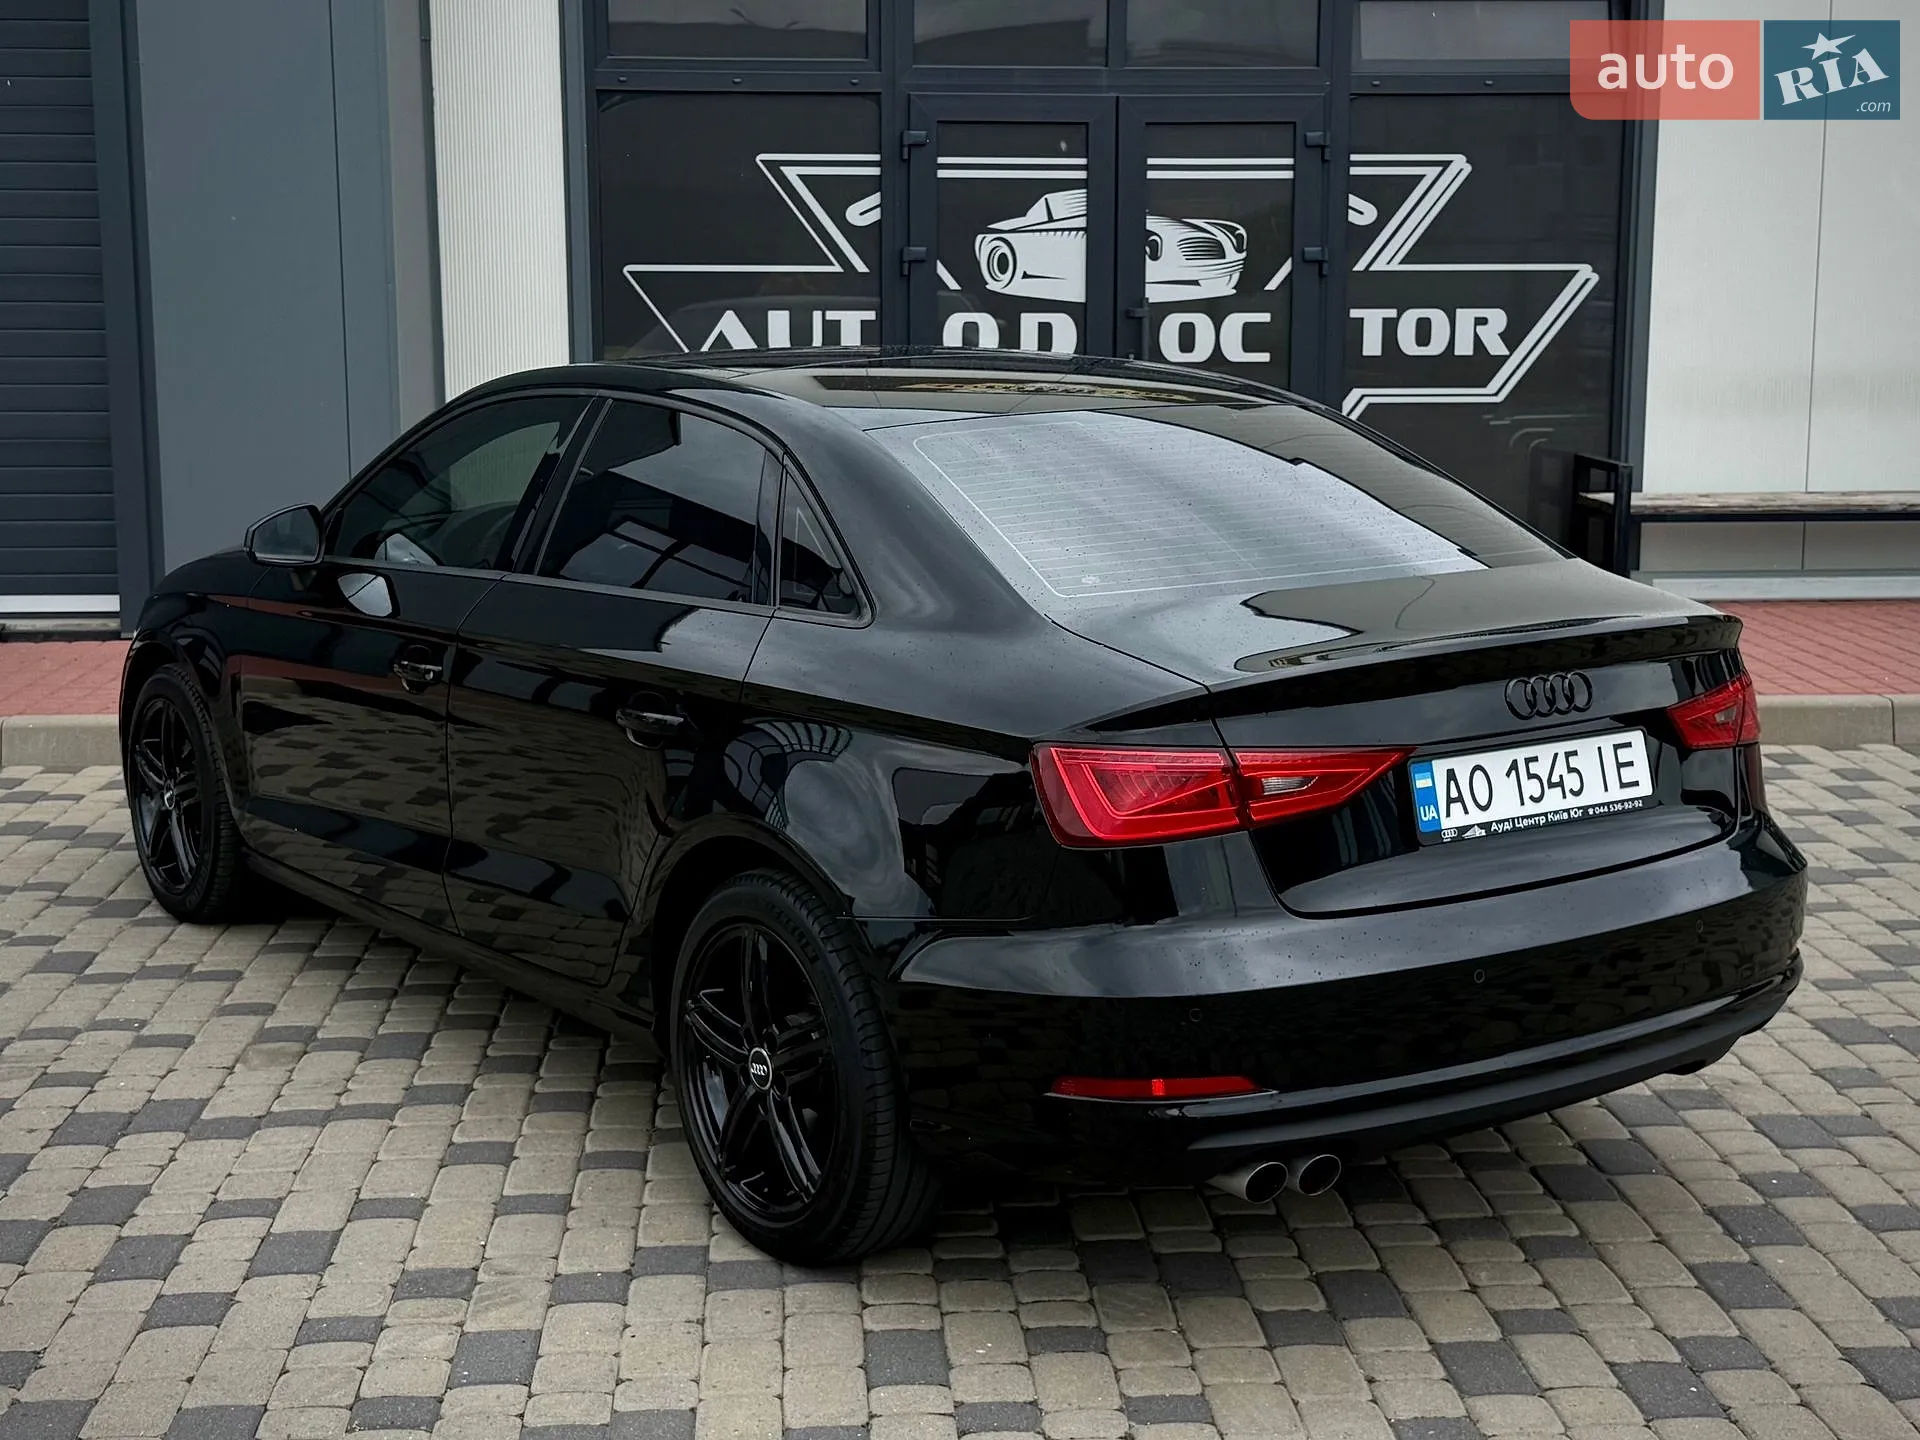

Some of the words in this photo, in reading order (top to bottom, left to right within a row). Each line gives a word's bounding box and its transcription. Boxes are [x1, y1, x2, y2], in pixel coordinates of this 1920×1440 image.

[1445, 764, 1493, 818] AO
[1505, 749, 1585, 807] 1545
[1597, 741, 1640, 792] IE
[1420, 804, 1439, 822] UA
[1515, 814, 1546, 828] Центр
[1569, 808, 1583, 818] Юг
[1594, 805, 1609, 815] 044
